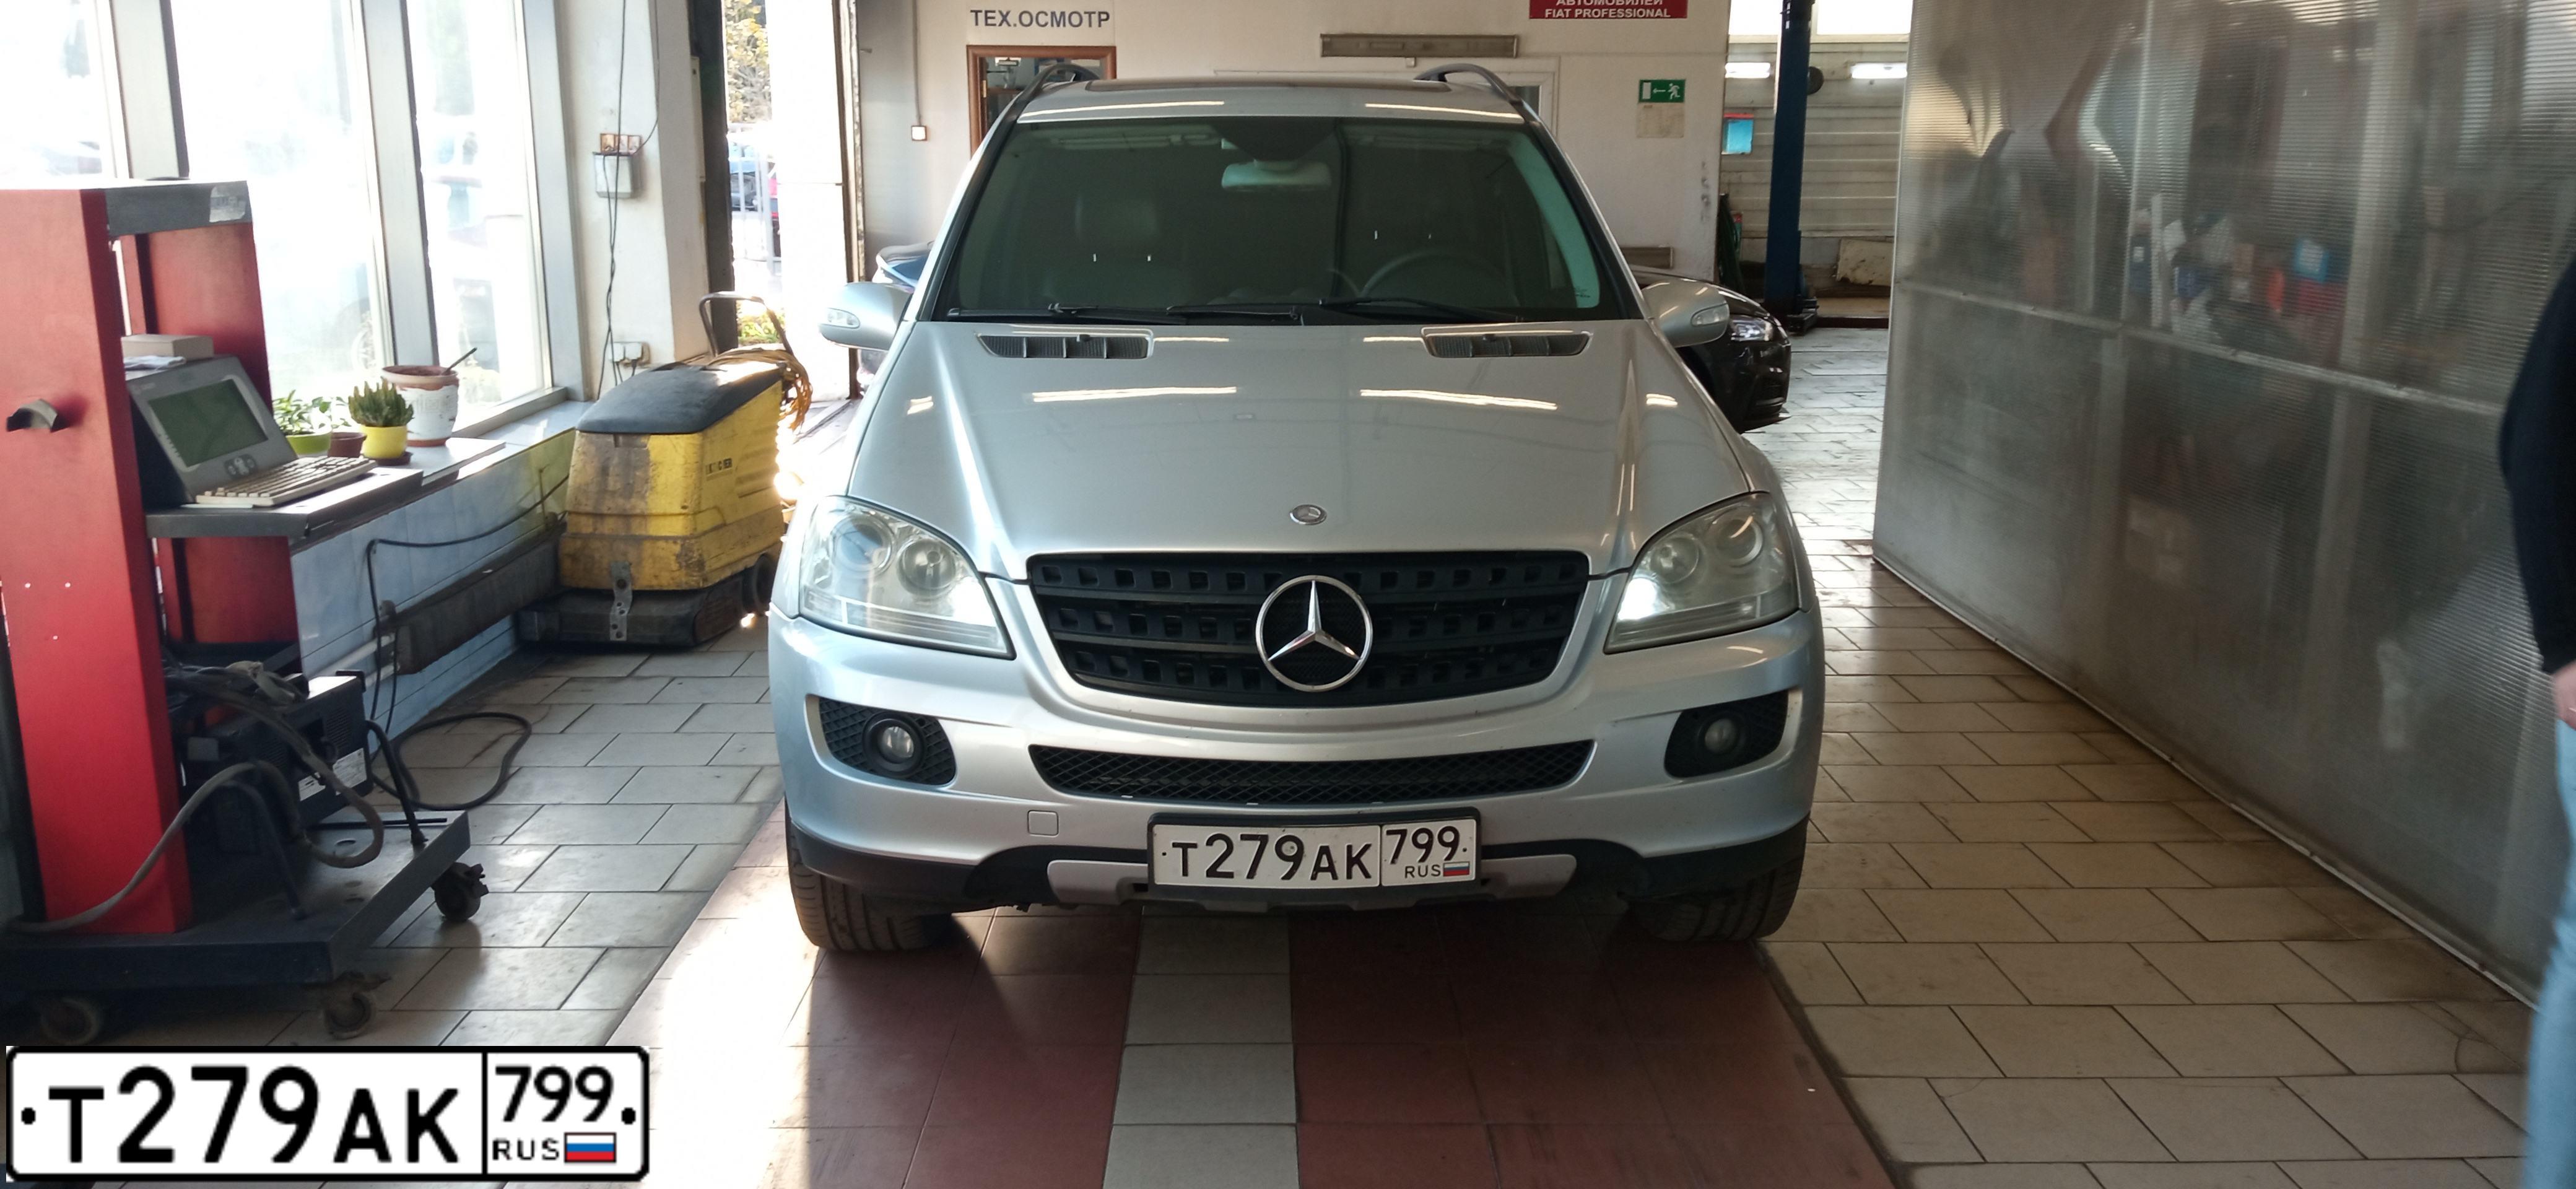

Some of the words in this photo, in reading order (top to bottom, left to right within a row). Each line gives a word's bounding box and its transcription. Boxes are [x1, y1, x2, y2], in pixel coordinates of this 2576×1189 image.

[970, 9, 1110, 28] ТЕХ.ОСМОТР
[1545, 8, 1572, 18] FIAT
[1575, 8, 1671, 18] PROFESSIONAL
[1172, 832, 1372, 881] Т279АК
[1385, 825, 1460, 865] 799
[1404, 865, 1442, 879] RUS
